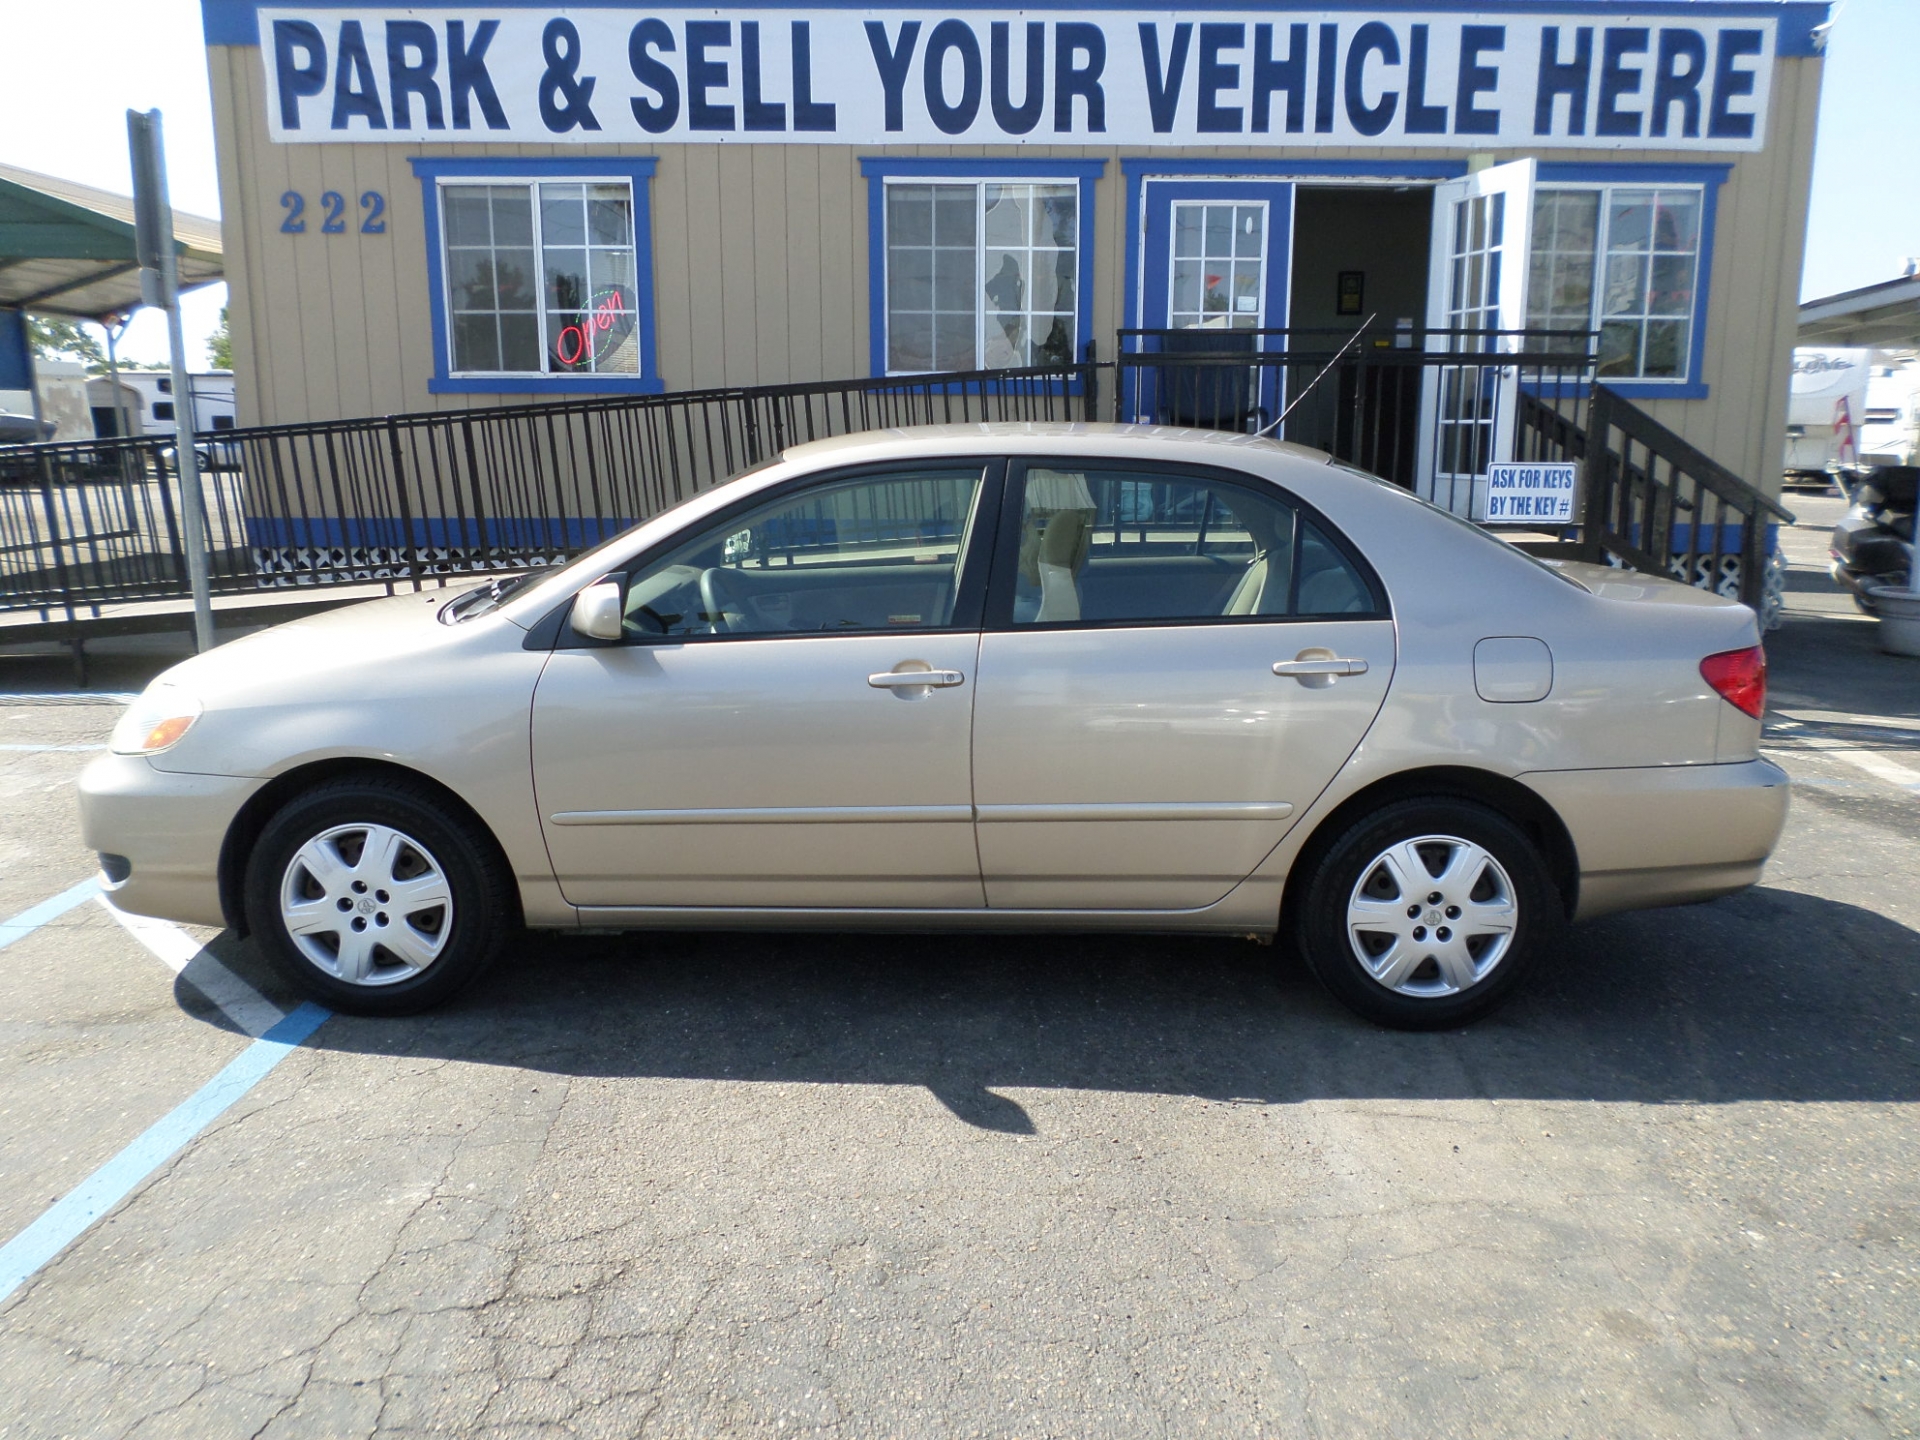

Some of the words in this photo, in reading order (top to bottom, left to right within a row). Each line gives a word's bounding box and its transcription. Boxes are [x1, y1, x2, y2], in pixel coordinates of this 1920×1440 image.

[272, 19, 510, 131] PARK
[538, 17, 603, 134] &
[628, 17, 837, 133] SELL
[862, 18, 1107, 135] YOUR
[1137, 20, 1506, 137] VEHICLE
[1533, 25, 1764, 139] HERE
[557, 291, 625, 364] Open
[1491, 469, 1517, 488] ASK
[1519, 469, 1541, 488] FOR
[1543, 469, 1573, 489] KEYS
[1490, 496, 1507, 515] BY
[1509, 496, 1533, 515] THE
[1534, 496, 1558, 515] KEY
[1559, 499, 1570, 516] #
